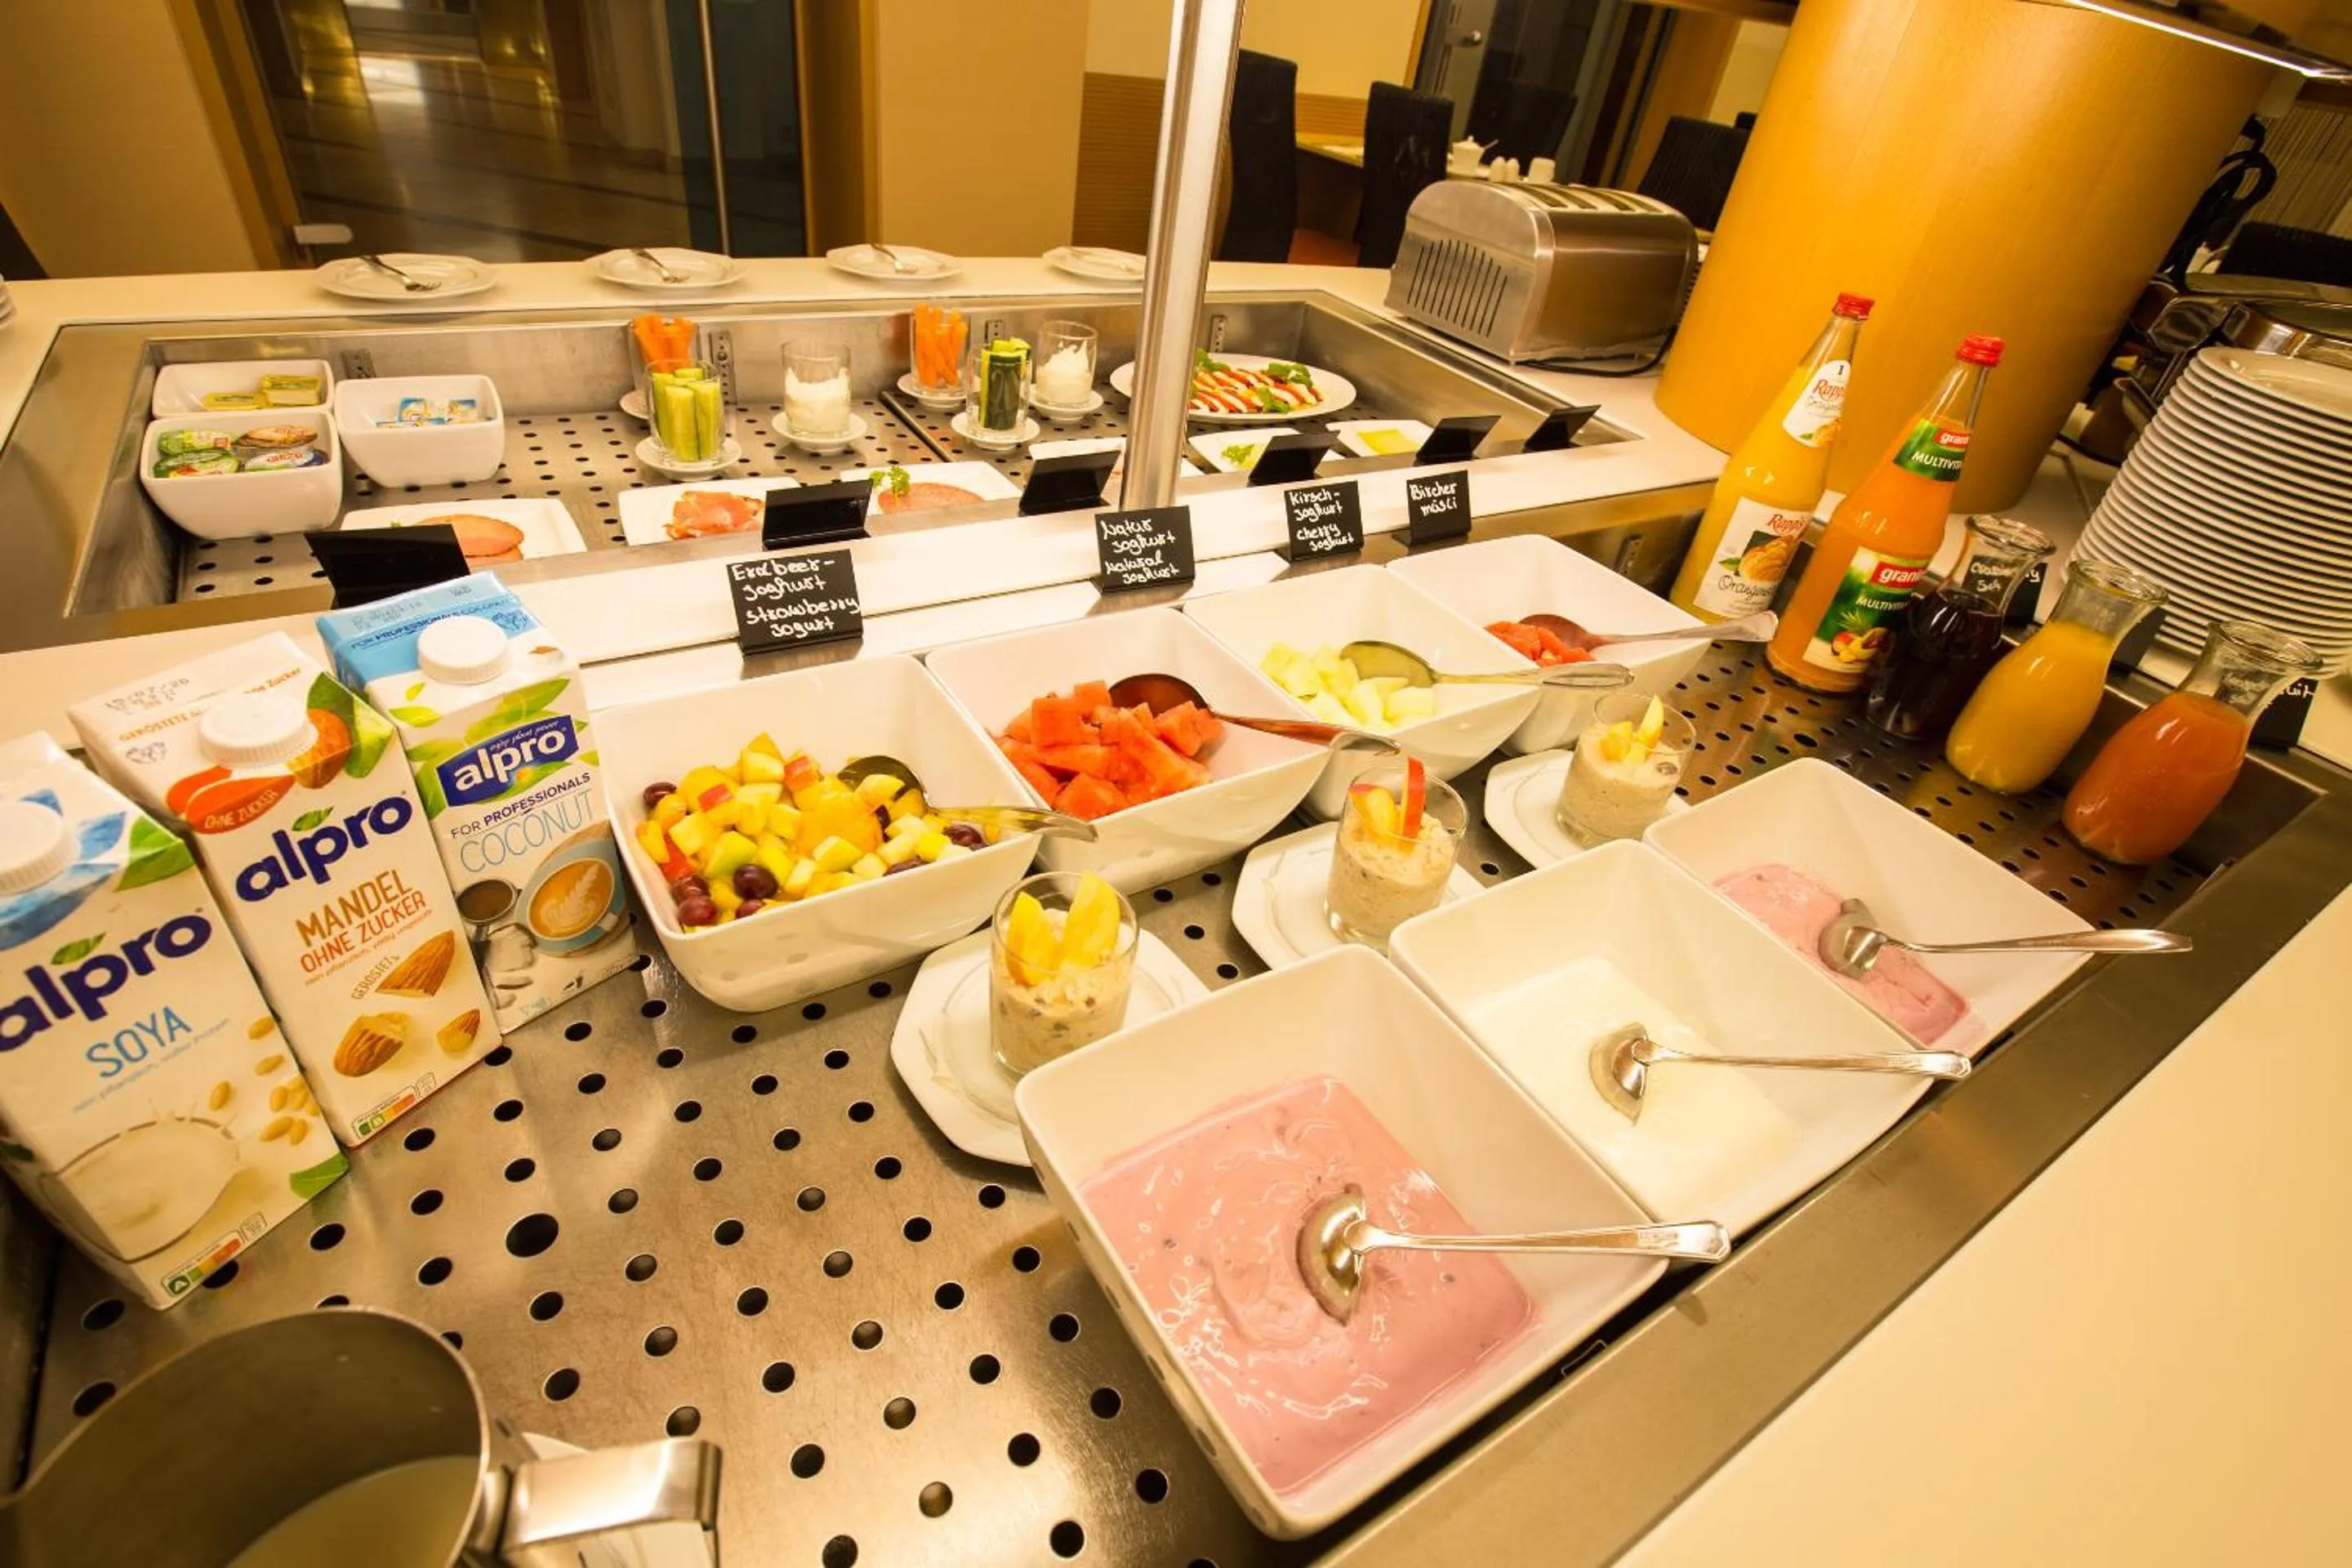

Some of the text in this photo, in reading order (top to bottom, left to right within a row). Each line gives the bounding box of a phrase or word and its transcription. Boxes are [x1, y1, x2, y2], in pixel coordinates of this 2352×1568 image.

[1409, 481, 1457, 501] Bircher
[454, 730, 565, 792] alpro
[204, 790, 278, 830] OHNE ZUCKER
[451, 772, 590, 840] FOR PROFESSIONALS
[461, 789, 593, 872] COCONUT
[236, 796, 412, 902] alpro
[296, 869, 412, 948] MANDEL
[300, 932, 355, 973] OHNE
[355, 890, 426, 944] ZUCKER
[0, 915, 212, 1052] alpro
[85, 1006, 192, 1078] SOYA
